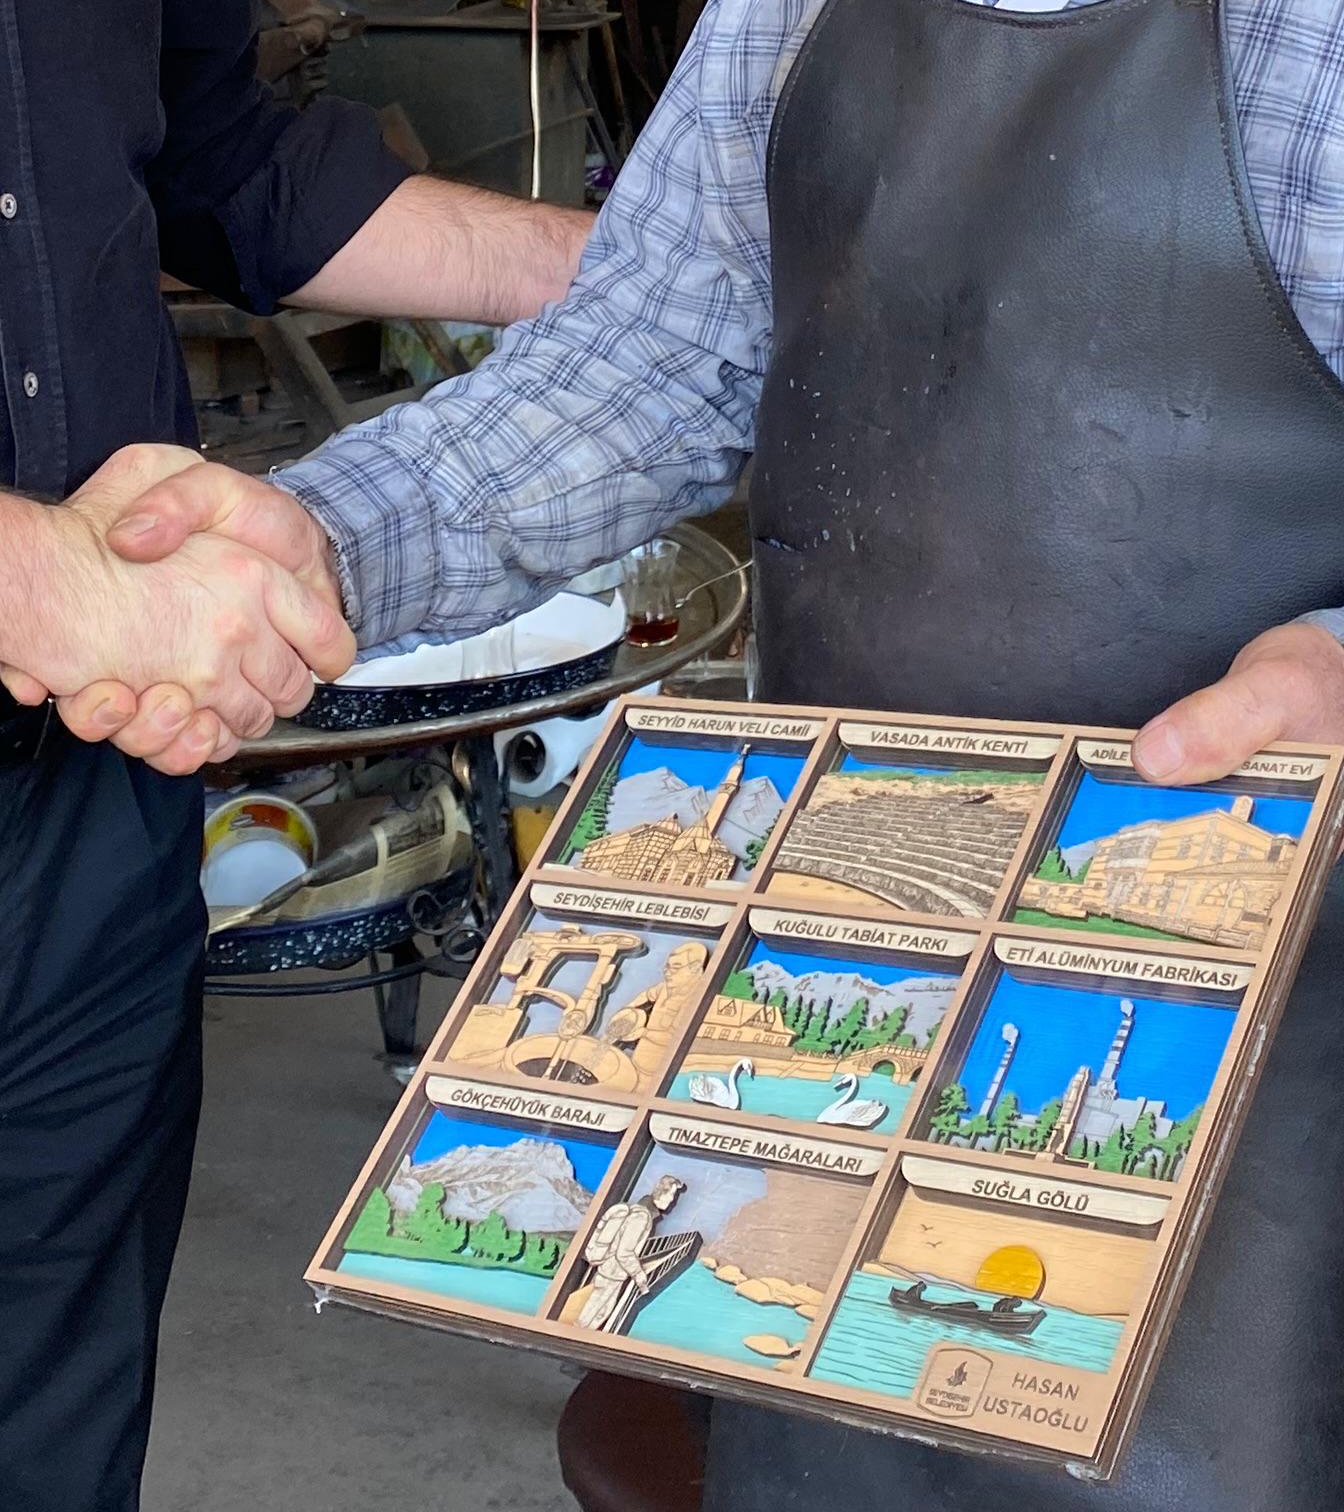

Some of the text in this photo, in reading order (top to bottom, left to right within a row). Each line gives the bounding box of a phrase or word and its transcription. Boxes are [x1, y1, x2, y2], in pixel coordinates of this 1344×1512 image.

[638, 714, 686, 728] SEYYİD
[687, 719, 736, 733] HARUN
[770, 723, 811, 737] CAMİİ
[870, 730, 1028, 754] VASADA ANTİK KENTİ
[1090, 747, 1129, 761] ADİLE
[1240, 761, 1313, 776] SANAT EVİ
[554, 892, 711, 921] SEYDİŞEHİR LEBLEBİSİ
[773, 919, 948, 952] KUĞULU TABİAT PARKI
[1006, 946, 1237, 987] ETİ ALÜMİNYUM FABRİKASI
[451, 1089, 605, 1126] GÖKÇEHÜYÜK BARAJI
[668, 1127, 863, 1172] TINAZTEPE MAĞARALARI
[971, 1179, 1090, 1211] SUĞLA GÖLÜ
[1011, 1372, 1080, 1401] HASAN
[983, 1396, 1089, 1432] USTAOĞLU
